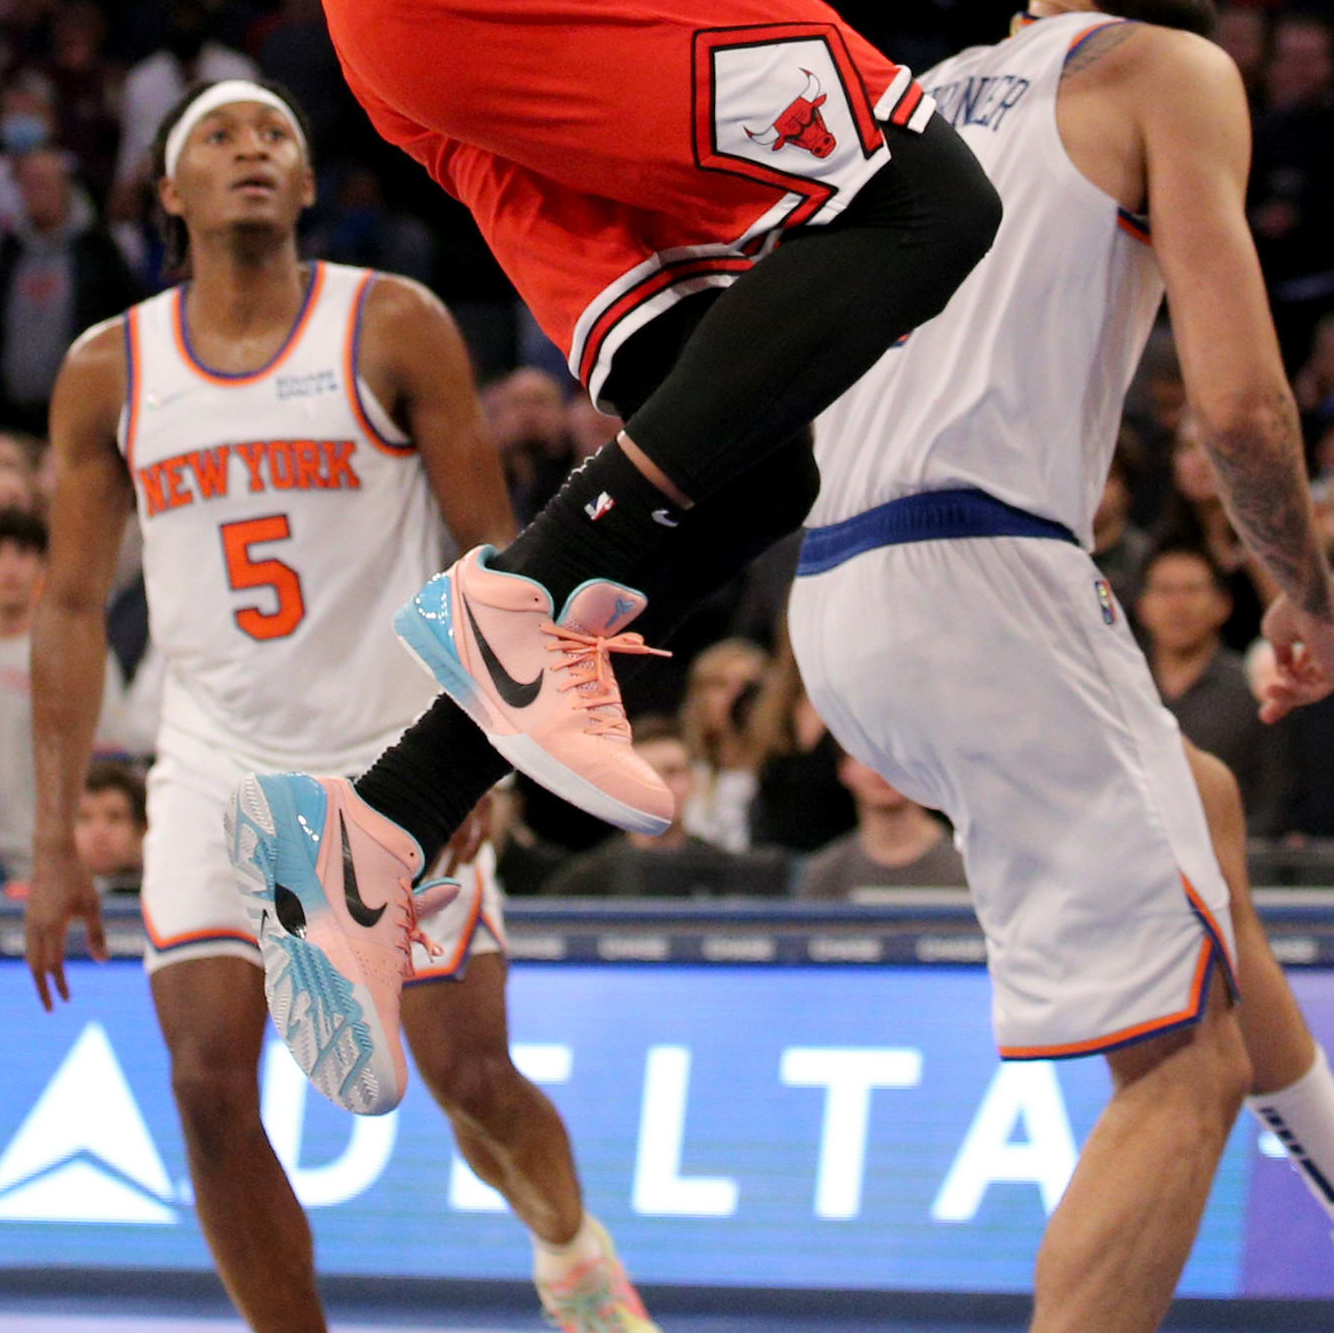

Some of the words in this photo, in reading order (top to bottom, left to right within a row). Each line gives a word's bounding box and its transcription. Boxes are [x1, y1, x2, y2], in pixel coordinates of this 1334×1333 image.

[139, 445, 230, 518] NEW
[234, 439, 361, 493] YORK
[219, 513, 306, 643] 5
